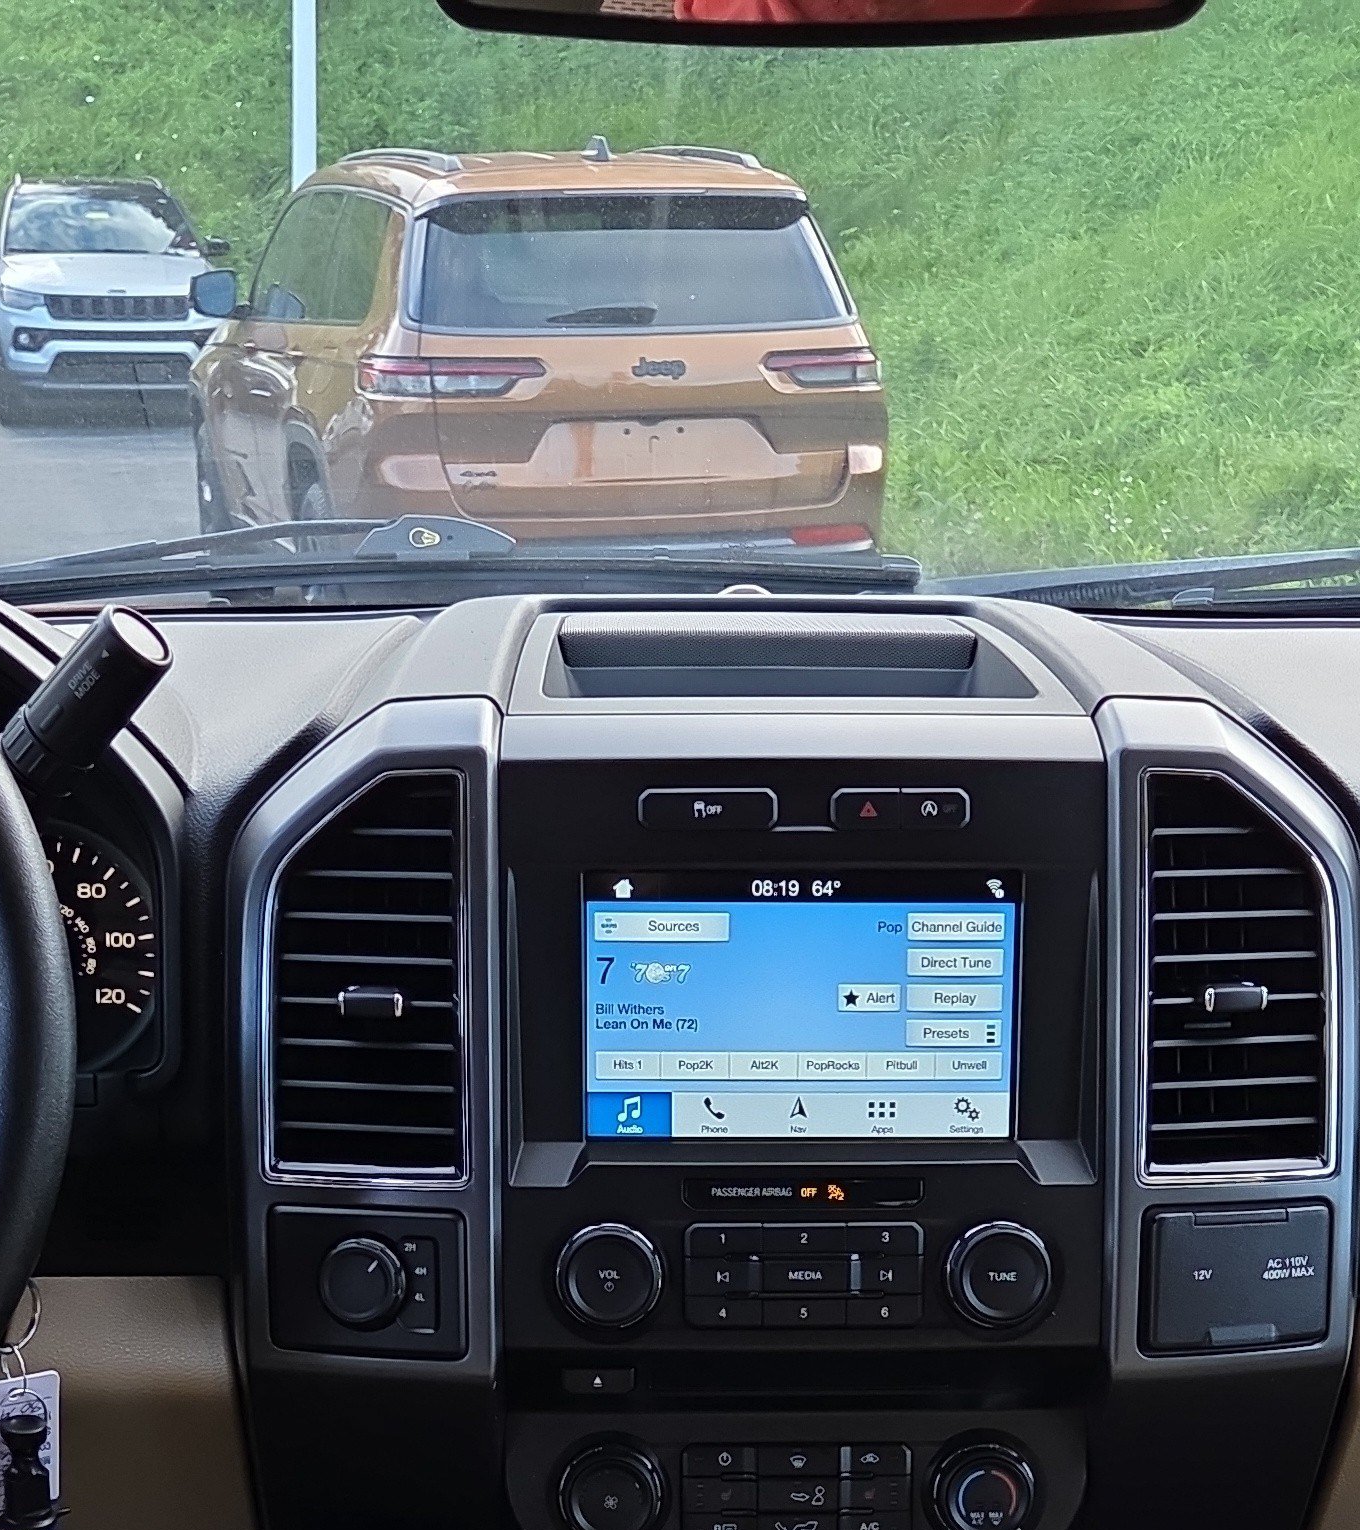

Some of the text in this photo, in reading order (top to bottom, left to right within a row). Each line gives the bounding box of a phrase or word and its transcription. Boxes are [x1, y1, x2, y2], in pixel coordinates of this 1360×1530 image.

[632, 357, 686, 380] Jeep
[68, 661, 93, 690] DRIVE
[74, 669, 100, 700] MODE
[77, 883, 106, 898] 80
[648, 920, 700, 933] Sources
[877, 921, 902, 935] Pop
[911, 921, 1003, 934] Channel Guide
[105, 932, 135, 948] 100
[921, 957, 992, 970] Direct Tune
[596, 957, 615, 985] 7
[96, 988, 125, 1004] 120
[867, 992, 895, 1005] Alert
[934, 992, 977, 1007] Replay
[595, 1003, 664, 1016] Bill Withers
[595, 1018, 698, 1033] Lean On Me (72)
[923, 1027, 969, 1040] Presets
[613, 1060, 634, 1071] Hits
[678, 1060, 713, 1074] Pop2K
[750, 1059, 779, 1072] Alt2K
[806, 1060, 860, 1074] PopRocks
[886, 1059, 918, 1072] Pitbull
[952, 1059, 987, 1072] Unwell
[617, 1125, 643, 1134] Audio
[701, 1125, 728, 1134] Phone
[790, 1125, 806, 1134] Nav
[871, 1125, 893, 1136] Apps
[949, 1125, 984, 1136] Settings
[711, 1187, 818, 1198] PASSENGER AIRBAG OFF
[719, 1233, 726, 1244] 1
[800, 1233, 808, 1244] 2
[881, 1231, 890, 1243] 3
[1267, 1256, 1308, 1269] AC 110V
[598, 1270, 620, 1280] VOL
[788, 1270, 823, 1281] MEDIA
[989, 1272, 1017, 1282] TUNE
[1193, 1270, 1213, 1280] 12V
[1262, 1266, 1314, 1280] 400W MAX
[718, 1308, 726, 1319] 4
[800, 1307, 808, 1319] 5
[881, 1307, 889, 1318] 6
